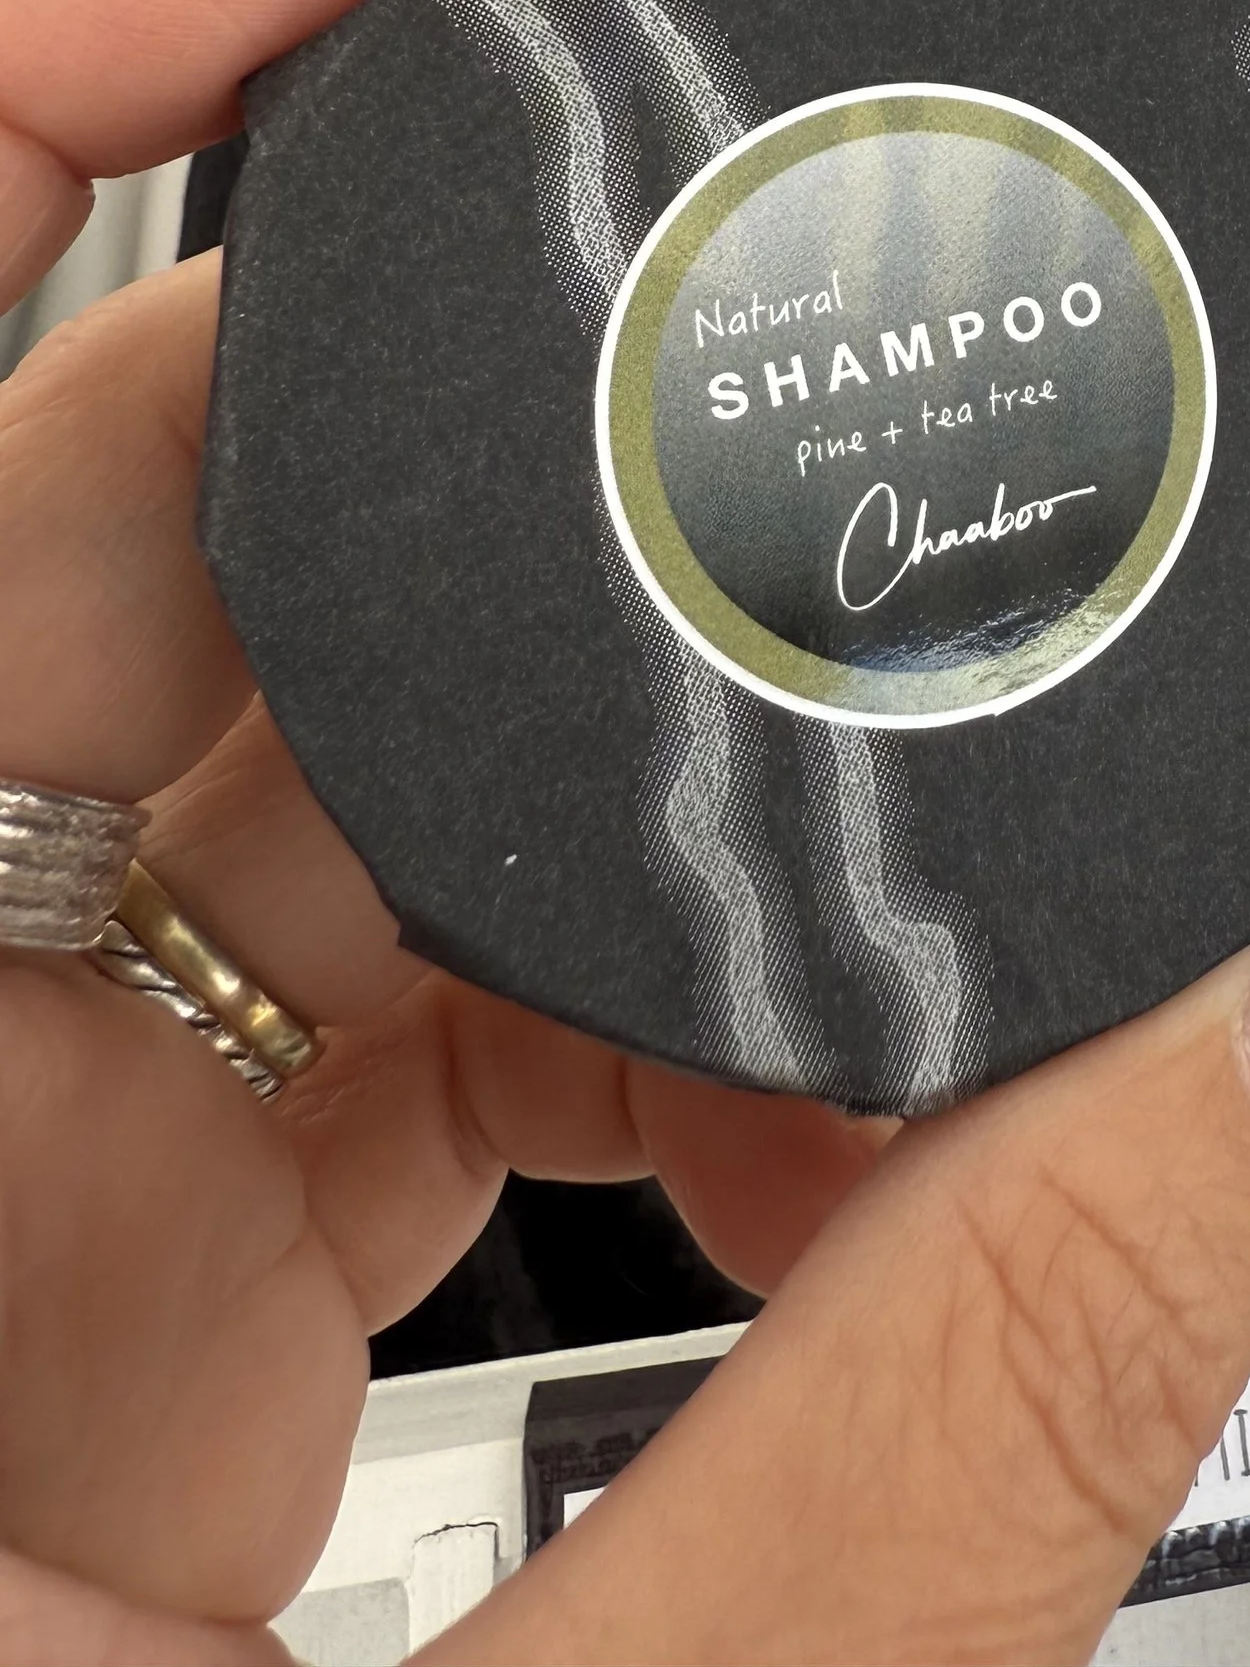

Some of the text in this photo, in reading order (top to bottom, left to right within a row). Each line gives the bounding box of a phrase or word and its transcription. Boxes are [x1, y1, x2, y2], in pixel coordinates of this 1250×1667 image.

[694, 270, 844, 348] Natural
[708, 281, 1102, 420] SHAMPOO
[796, 425, 867, 477] pine
[921, 396, 974, 435] tea
[988, 379, 1059, 413] tree
[836, 480, 1098, 612] Chaaboo
